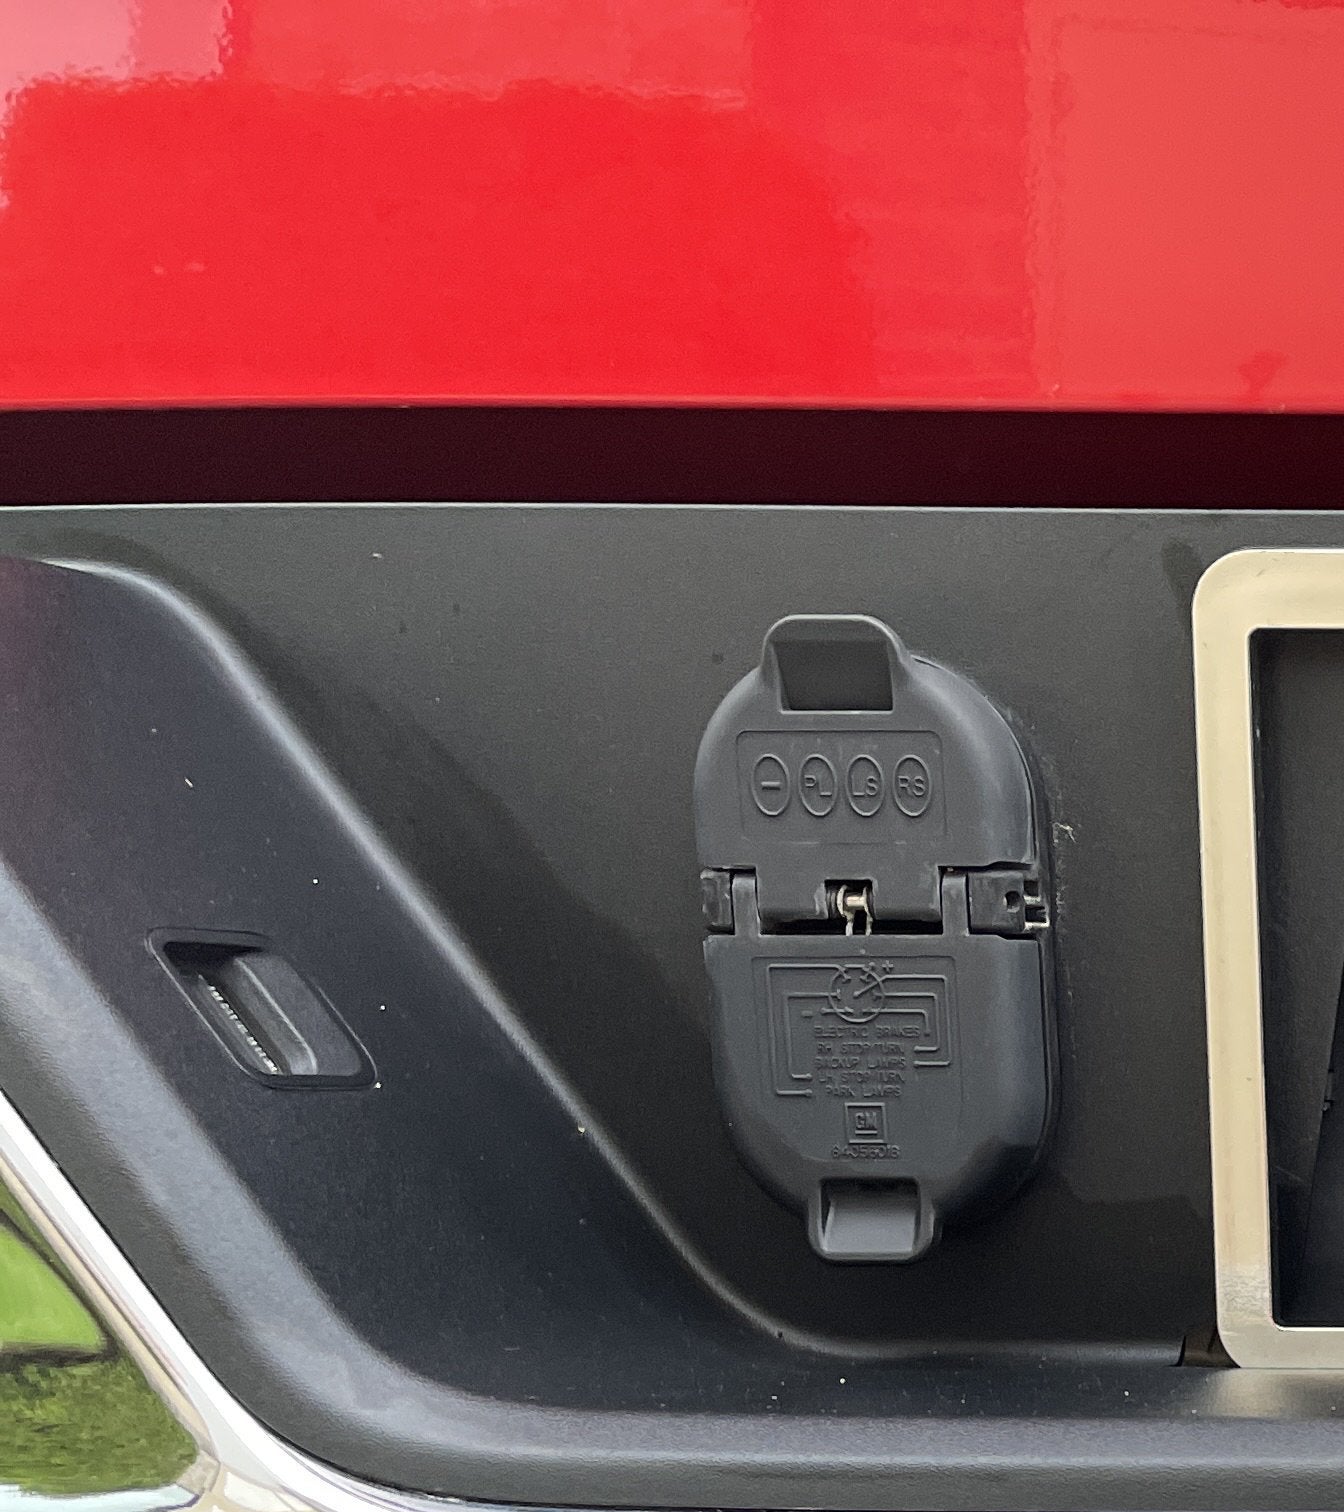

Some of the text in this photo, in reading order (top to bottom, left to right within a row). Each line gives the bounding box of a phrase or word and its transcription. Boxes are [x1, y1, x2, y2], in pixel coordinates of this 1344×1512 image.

[803, 773, 834, 797] PL
[851, 774, 880, 797] LS
[897, 775, 927, 797] RS
